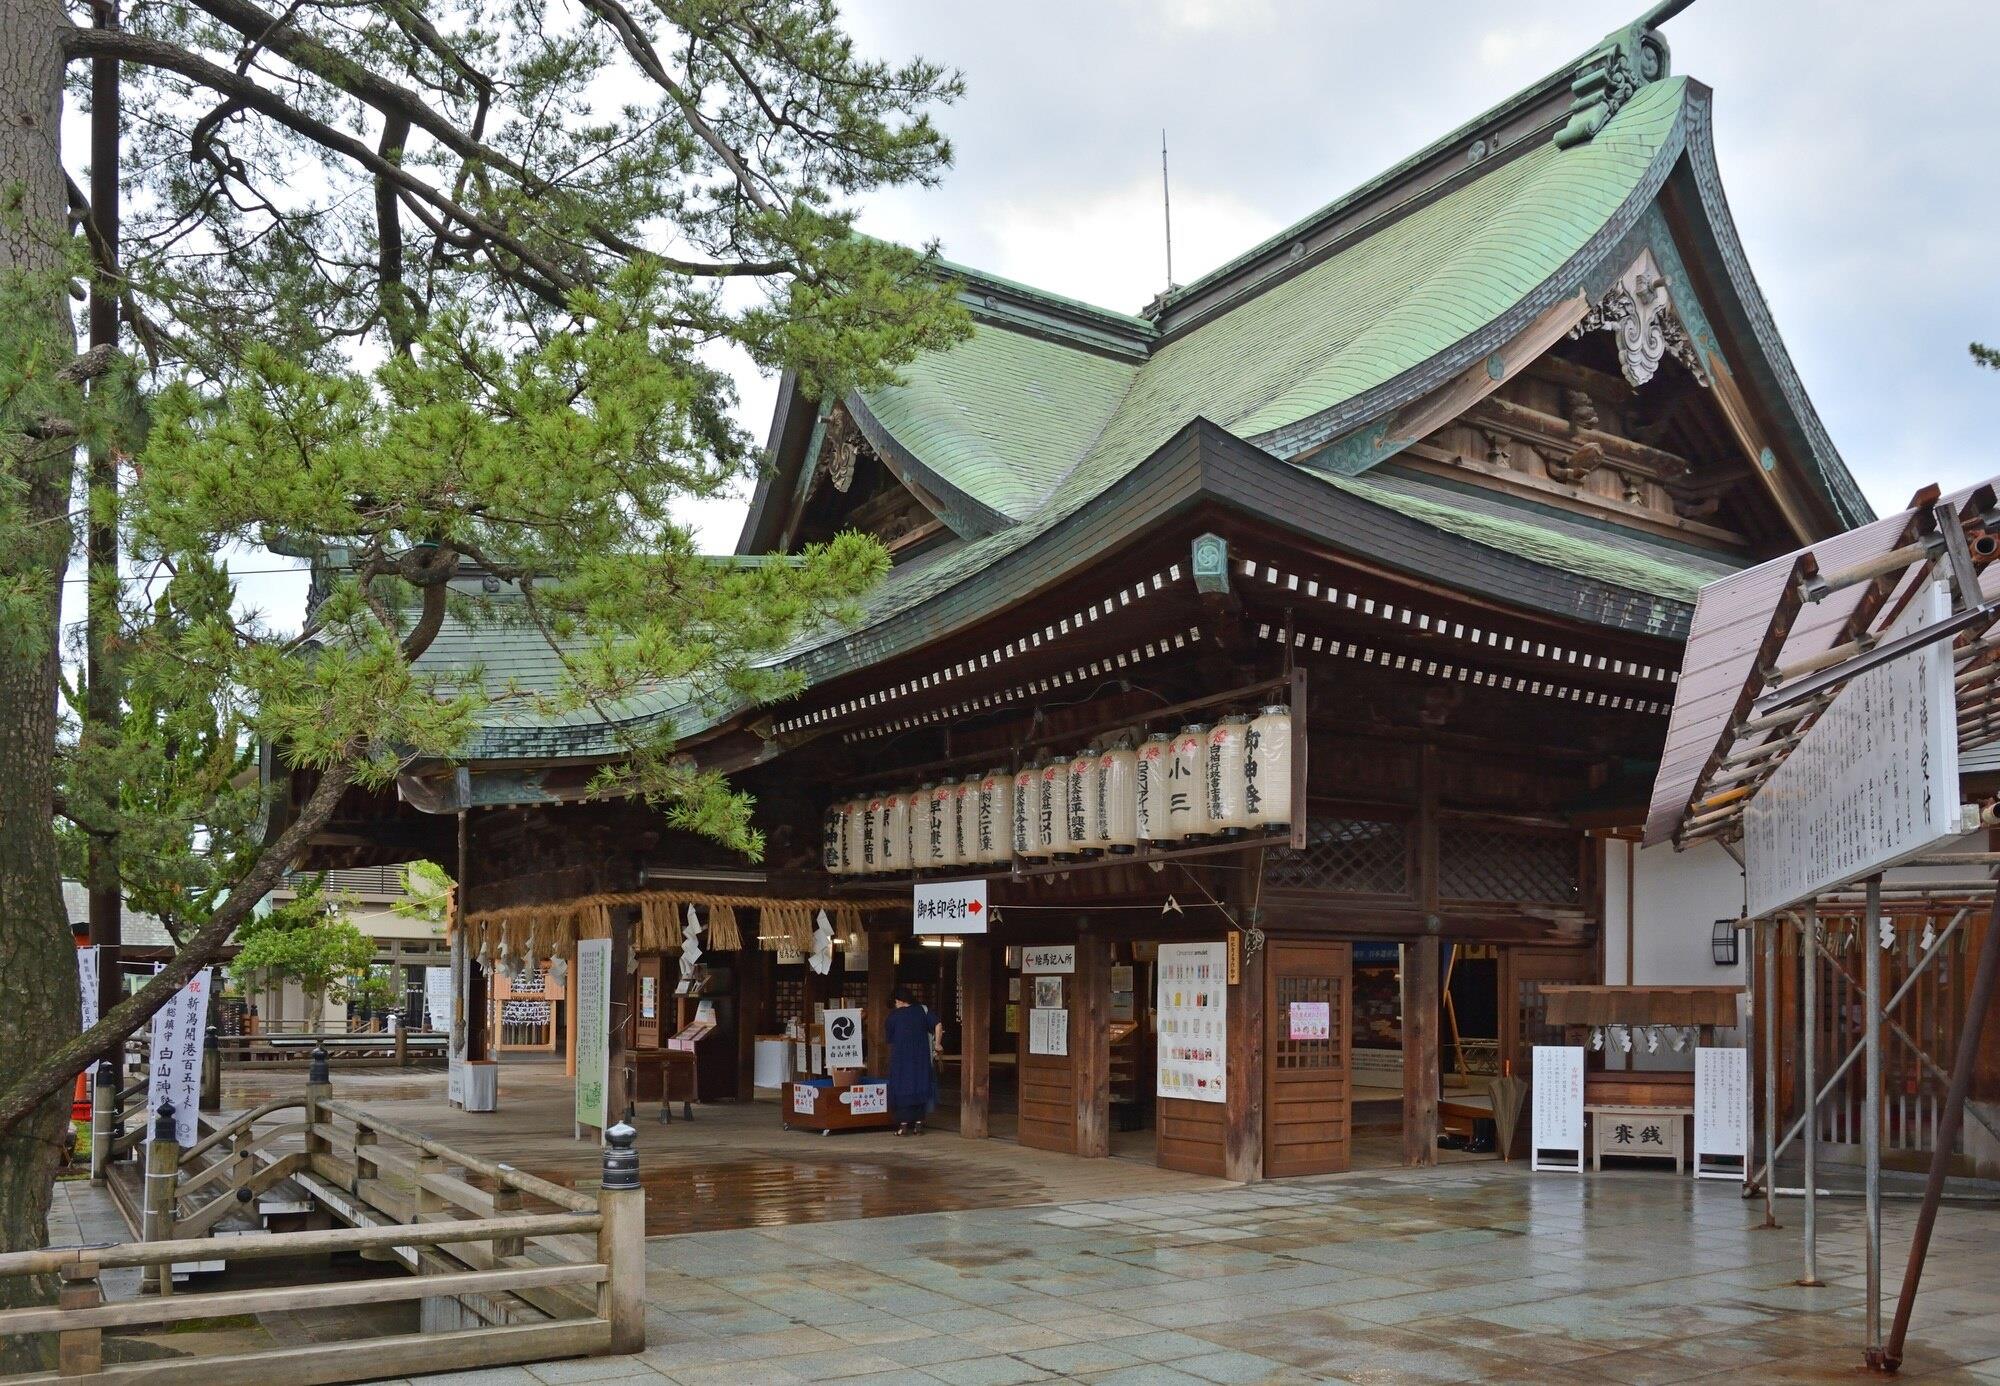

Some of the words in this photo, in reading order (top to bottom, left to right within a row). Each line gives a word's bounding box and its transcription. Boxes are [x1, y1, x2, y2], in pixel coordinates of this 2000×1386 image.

[917, 898, 968, 920] 御朱印受付
[1034, 953, 1073, 966] 絵馬記入所
[189, 980, 201, 993] 祝
[1614, 1123, 1664, 1146] 賽銭
